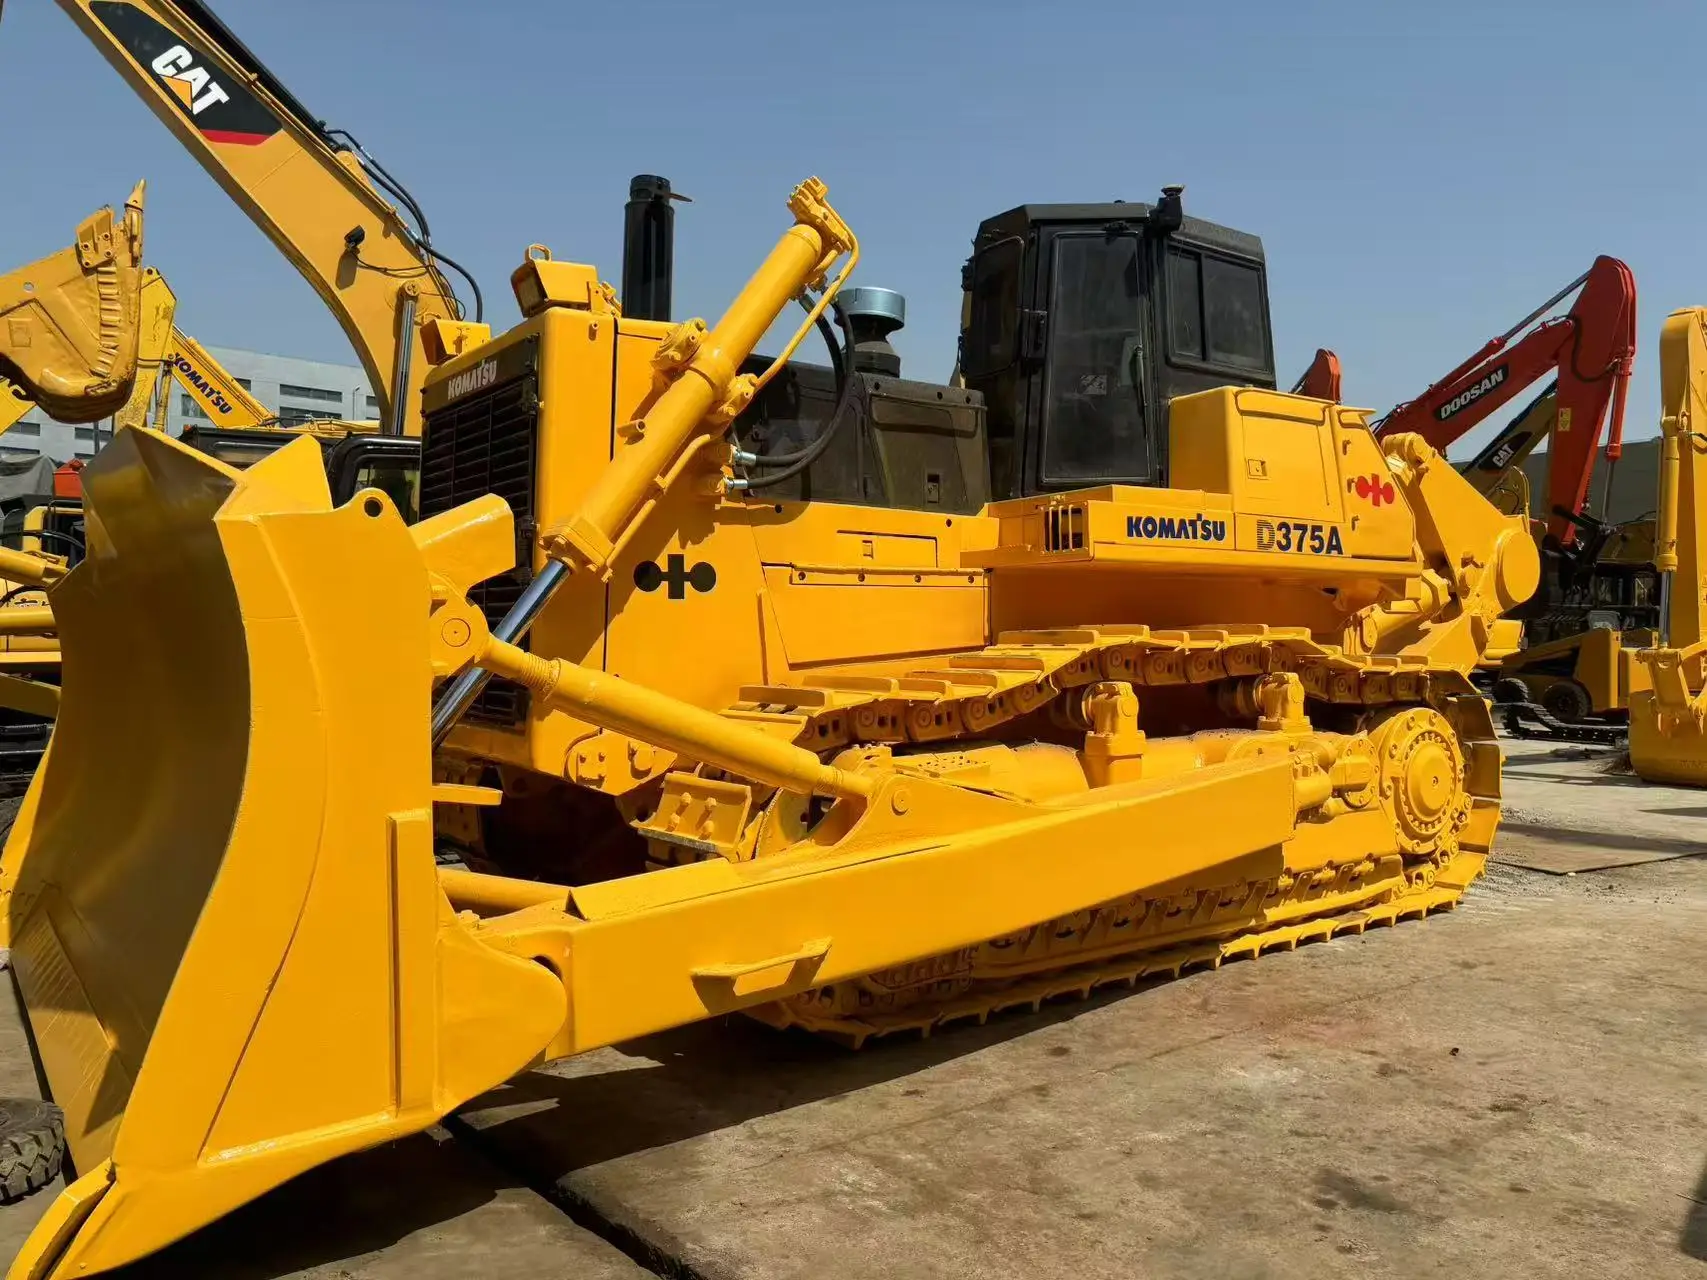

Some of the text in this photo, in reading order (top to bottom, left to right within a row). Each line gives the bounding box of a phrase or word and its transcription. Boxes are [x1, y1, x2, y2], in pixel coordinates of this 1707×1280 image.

[152, 45, 230, 115] CAT
[173, 352, 232, 414] KOMATSU
[448, 359, 497, 400] KOMATSU
[1441, 368, 1504, 419] DOOSAN
[1492, 443, 1515, 467] CAT
[1127, 513, 1344, 555] KOMATSU D375A
